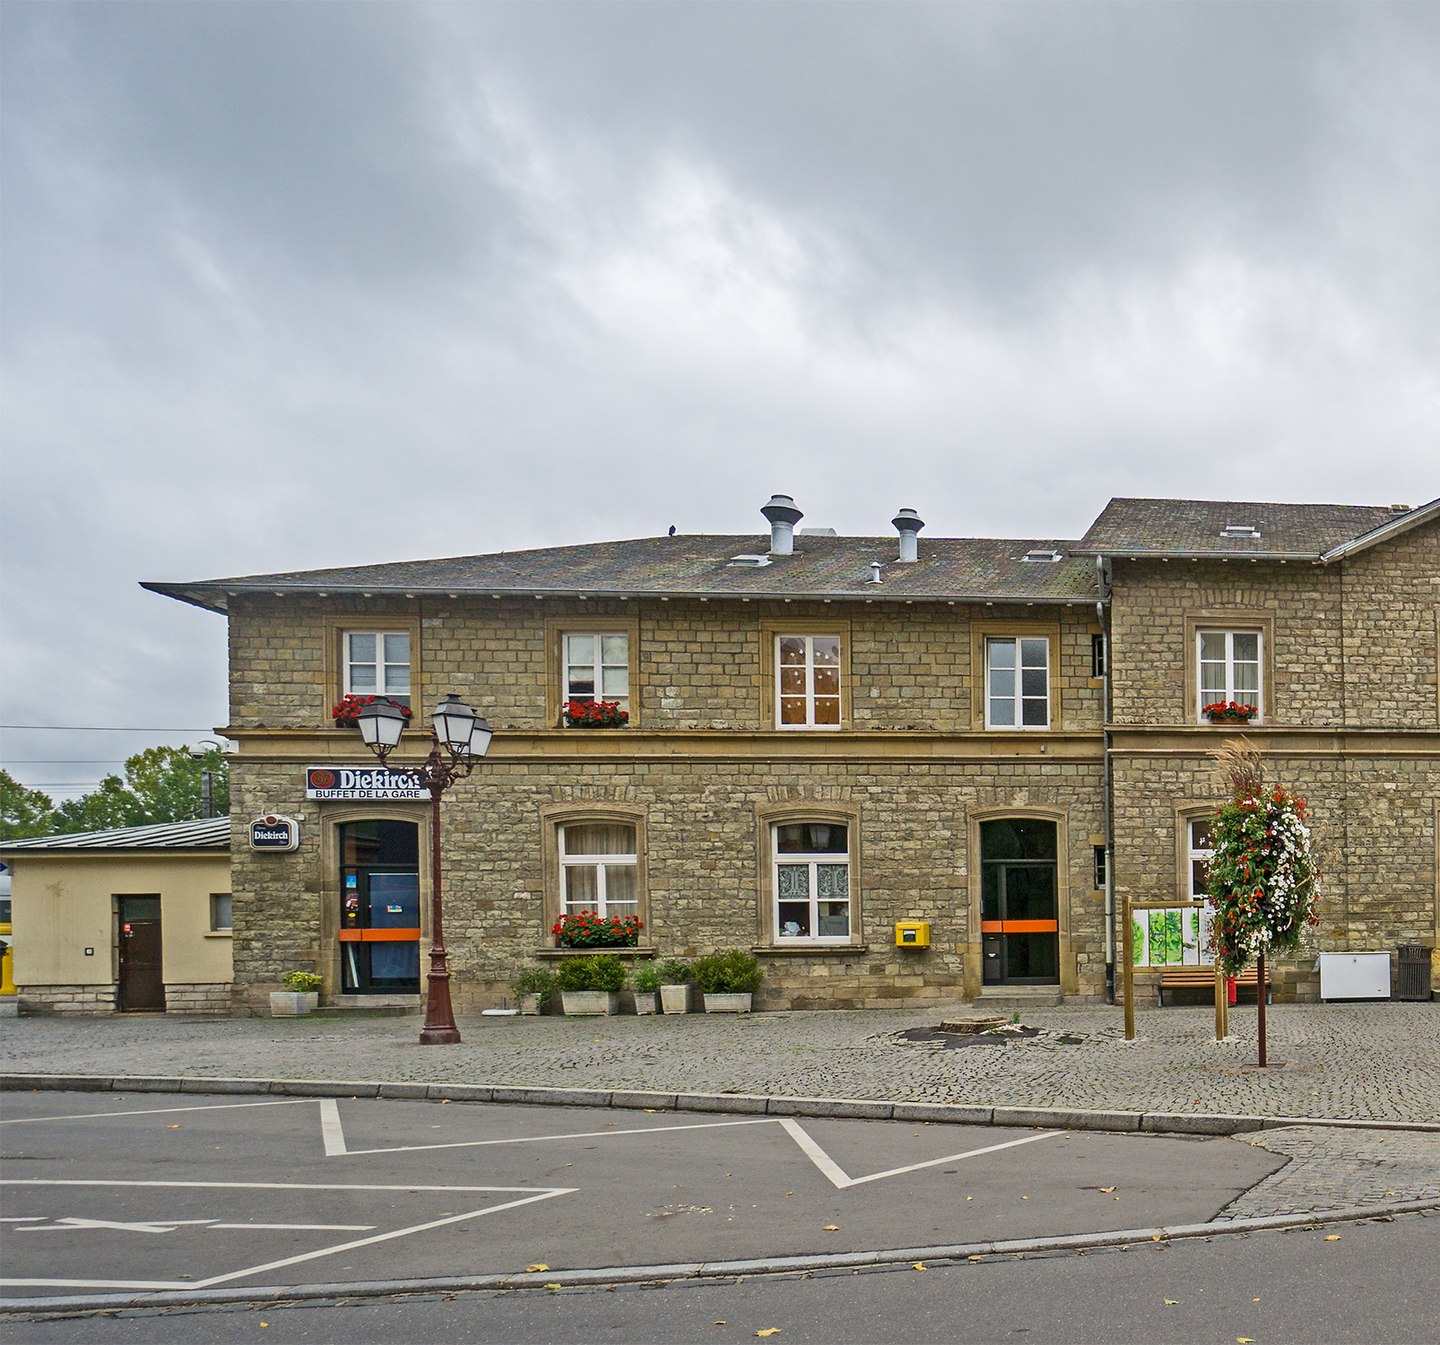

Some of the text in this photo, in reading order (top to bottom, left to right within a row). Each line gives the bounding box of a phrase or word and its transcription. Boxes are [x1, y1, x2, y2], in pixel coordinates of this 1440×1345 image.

[340, 770, 420, 789] Diekirch
[316, 790, 420, 798] BUFFET DE LA GARE
[254, 831, 288, 839] Diekirch
